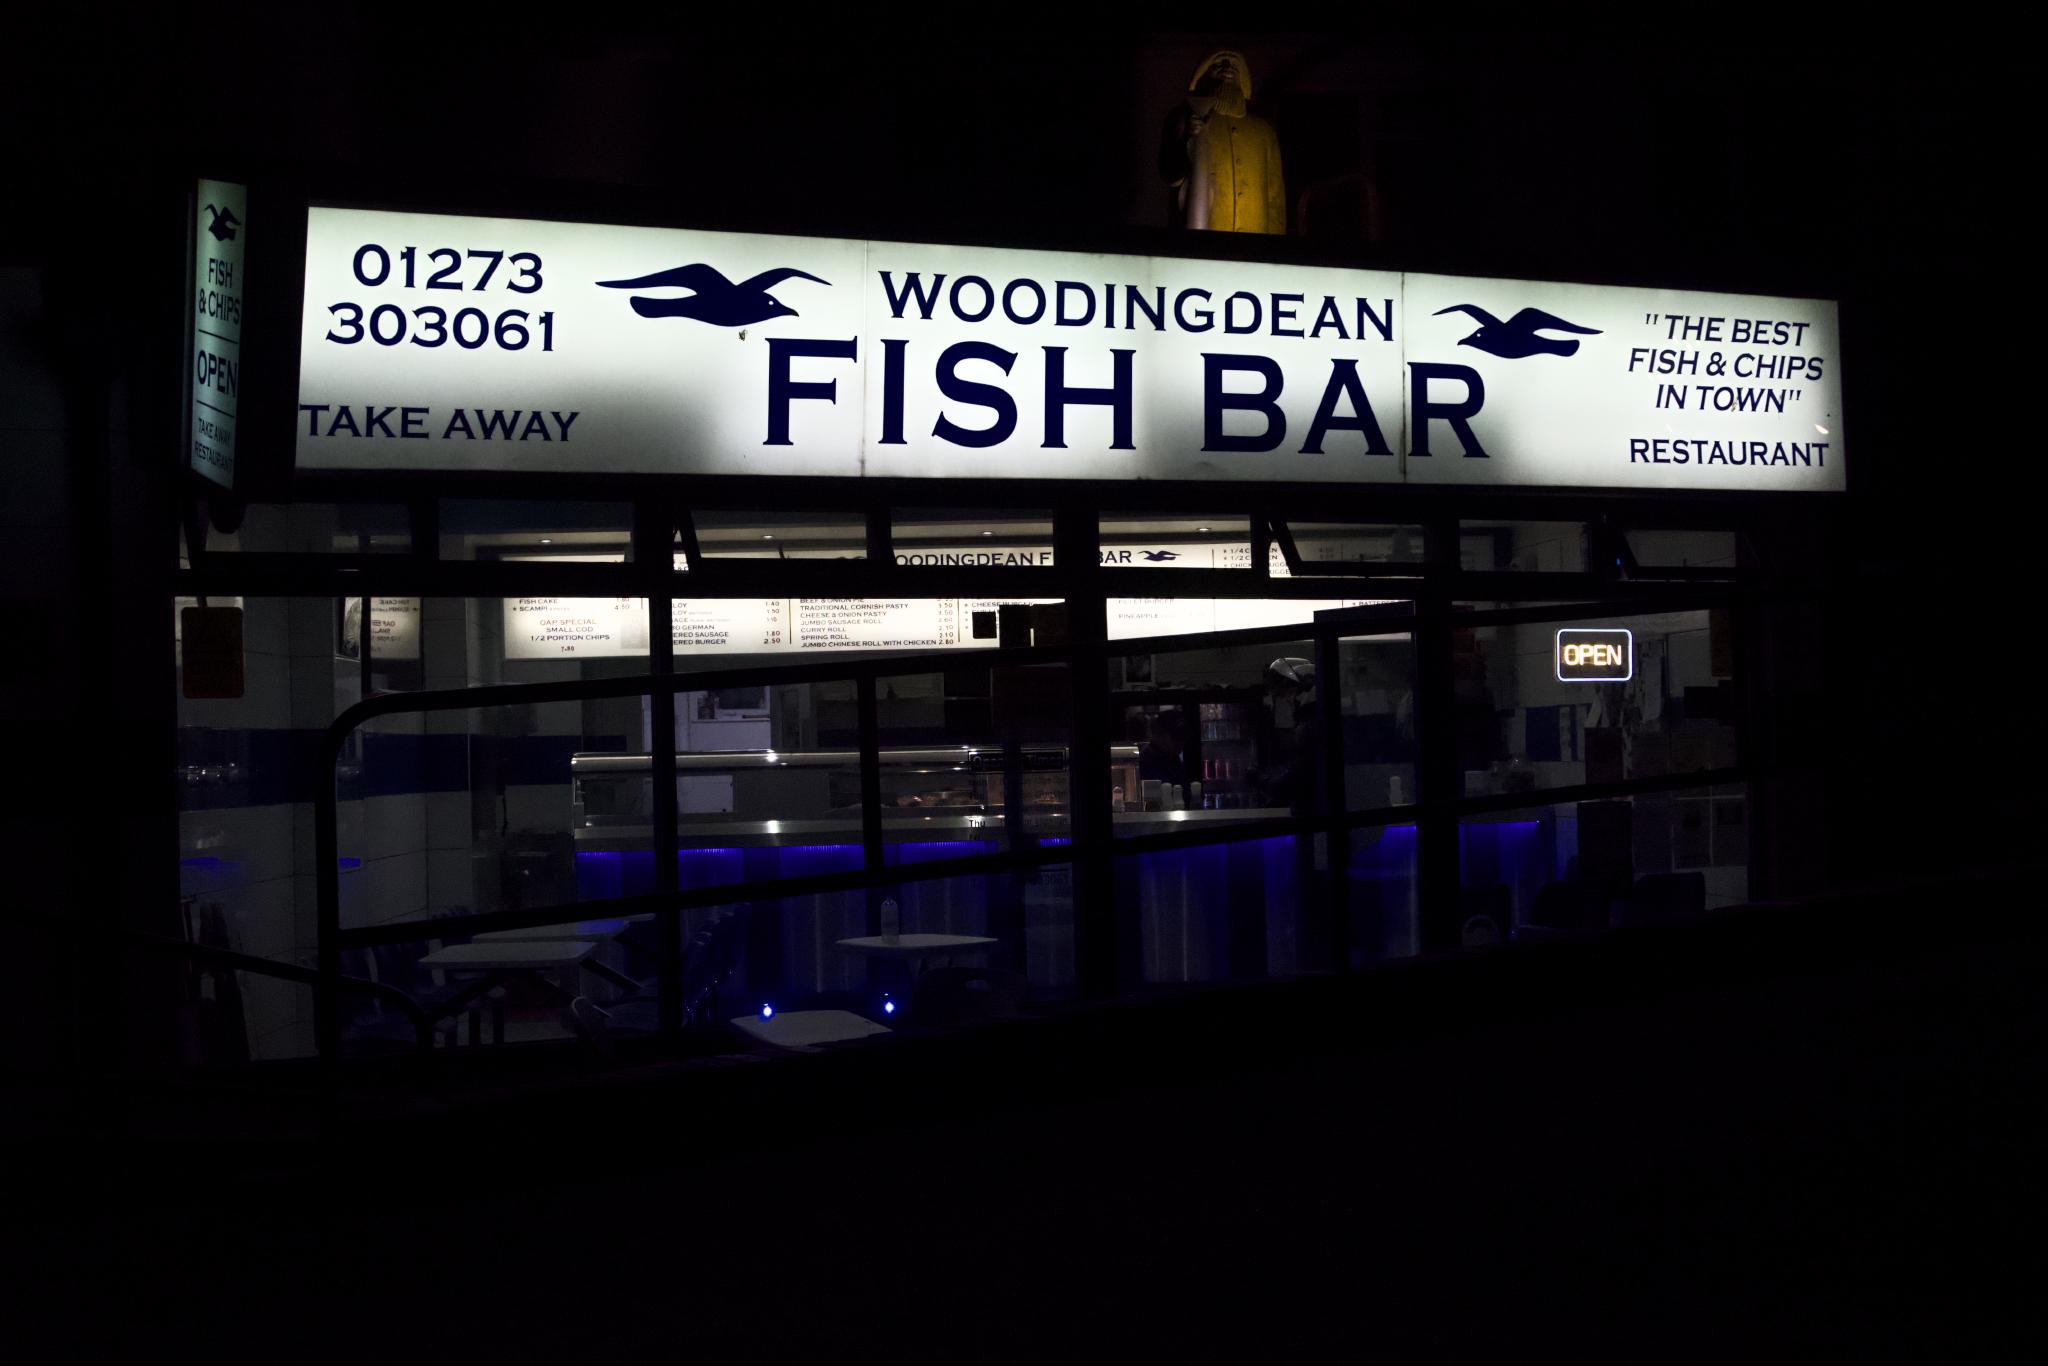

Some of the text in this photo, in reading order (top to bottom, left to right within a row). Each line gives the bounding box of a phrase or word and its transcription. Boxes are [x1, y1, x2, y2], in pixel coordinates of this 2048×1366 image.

[208, 258, 233, 289] FISH
[353, 243, 543, 294] 01273
[199, 288, 240, 326] & CHIPS
[877, 270, 1395, 341] WOODINGDEAN
[326, 302, 554, 352] 303061
[1731, 318, 1810, 346] BEST
[197, 350, 238, 398] OPEN
[1628, 347, 1824, 381] FISH & CHIPS
[763, 335, 1490, 458] FISH BAR
[1656, 384, 1688, 409] IN
[199, 418, 232, 446] TAKE AWAY
[299, 403, 580, 442] TAKE AWAY
[195, 440, 233, 472] RESTAURANT
[1630, 438, 1829, 466] RESTAURANT
[895, 552, 1034, 565] OODINGDEAN
[1564, 643, 1622, 666] OPEN
